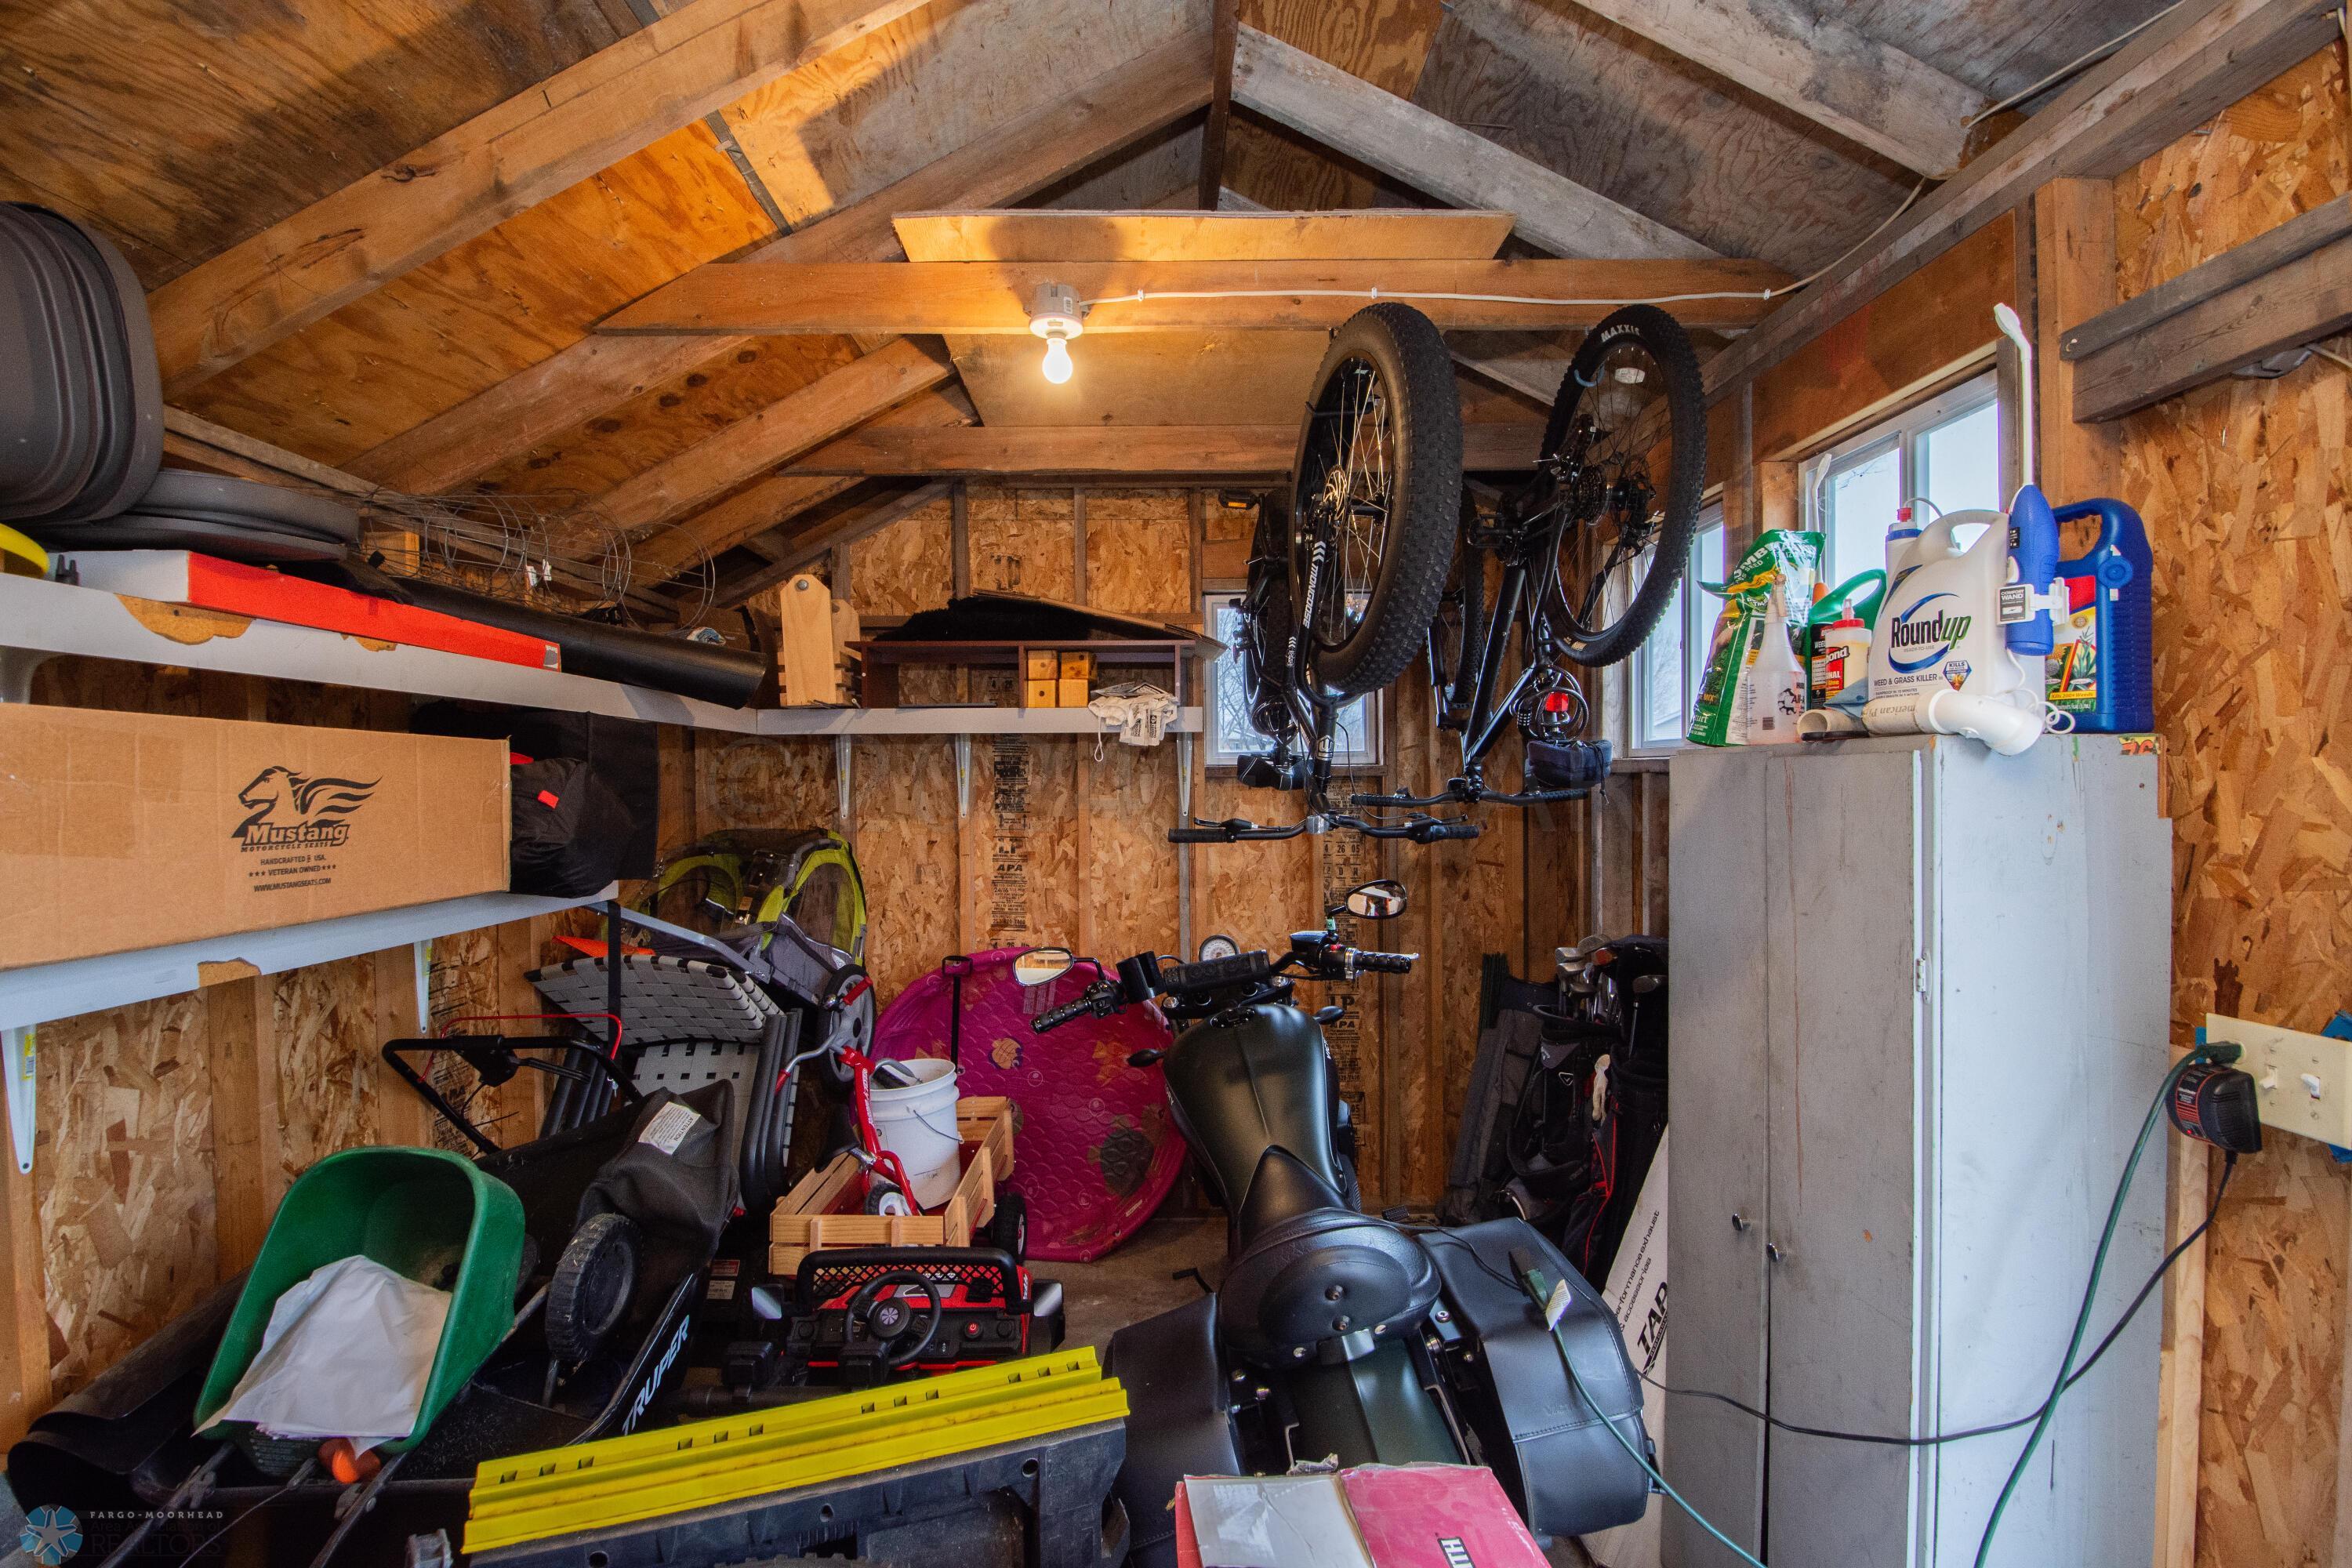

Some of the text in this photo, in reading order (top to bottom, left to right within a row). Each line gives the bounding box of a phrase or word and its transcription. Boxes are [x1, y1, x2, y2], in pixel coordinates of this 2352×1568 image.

[1302, 563, 1319, 630] MONGOOSE
[1891, 609, 1972, 651] Roundup
[1827, 646, 1849, 662] ond
[1874, 678, 1888, 687] WEED
[1893, 676, 1915, 684] GRASS
[1916, 673, 1937, 682] KILLER
[1879, 704, 1915, 716] merican
[241, 821, 350, 847] Mustang
[241, 843, 301, 853] MOTORCYCLE
[1337, 844, 1345, 854] 26
[1351, 844, 1360, 854] 05
[260, 855, 306, 866] HANDCRAFTED
[996, 863, 1023, 872] APA
[267, 865, 321, 877] VETERAN OWNED
[253, 877, 332, 892] WWW.MUSTANGSEATS.COM
[673, 1117, 694, 1142] ATTENTION
[1640, 1210, 1660, 1254] exhaust
[1624, 1257, 1652, 1323] accessories
[622, 1314, 690, 1436] TRUPER
